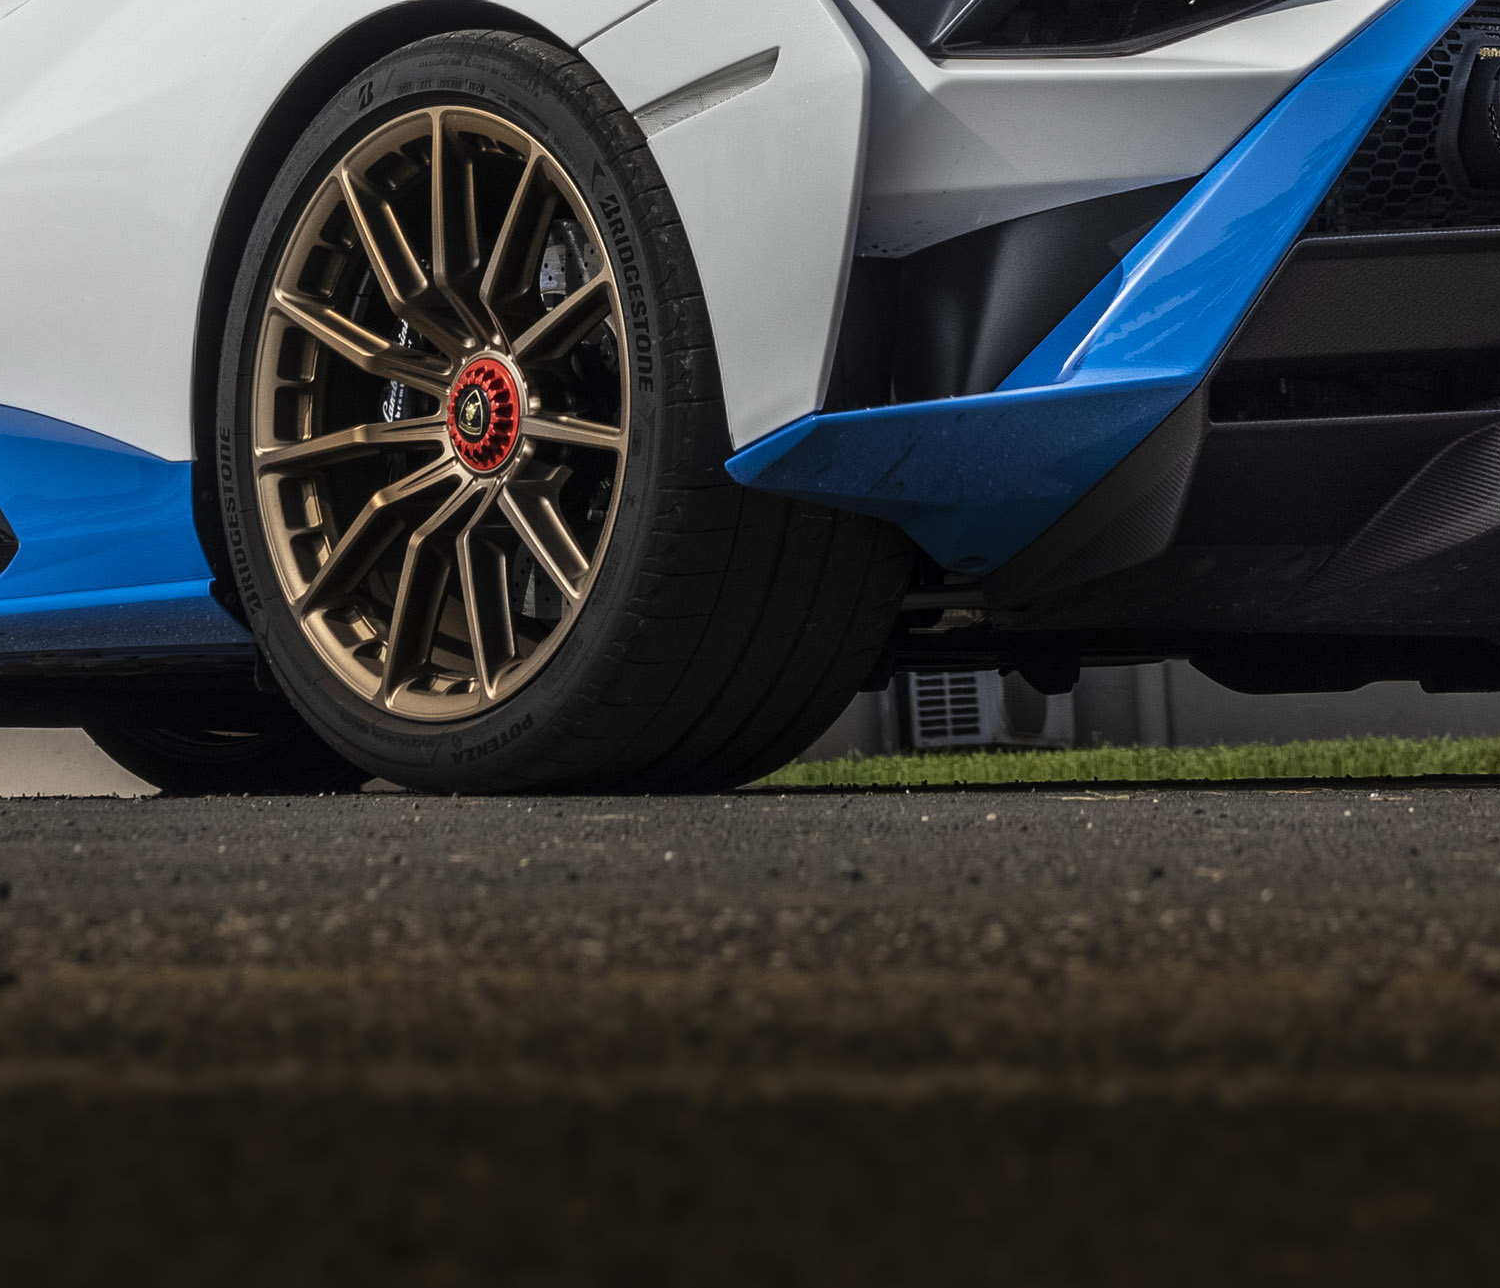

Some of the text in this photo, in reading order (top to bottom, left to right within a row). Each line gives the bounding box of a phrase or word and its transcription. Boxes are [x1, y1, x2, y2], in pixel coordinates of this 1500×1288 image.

[598, 193, 654, 393] BRIDGESTONE
[220, 426, 263, 616] BRIDGESTONE
[450, 712, 535, 765] POTENZA
